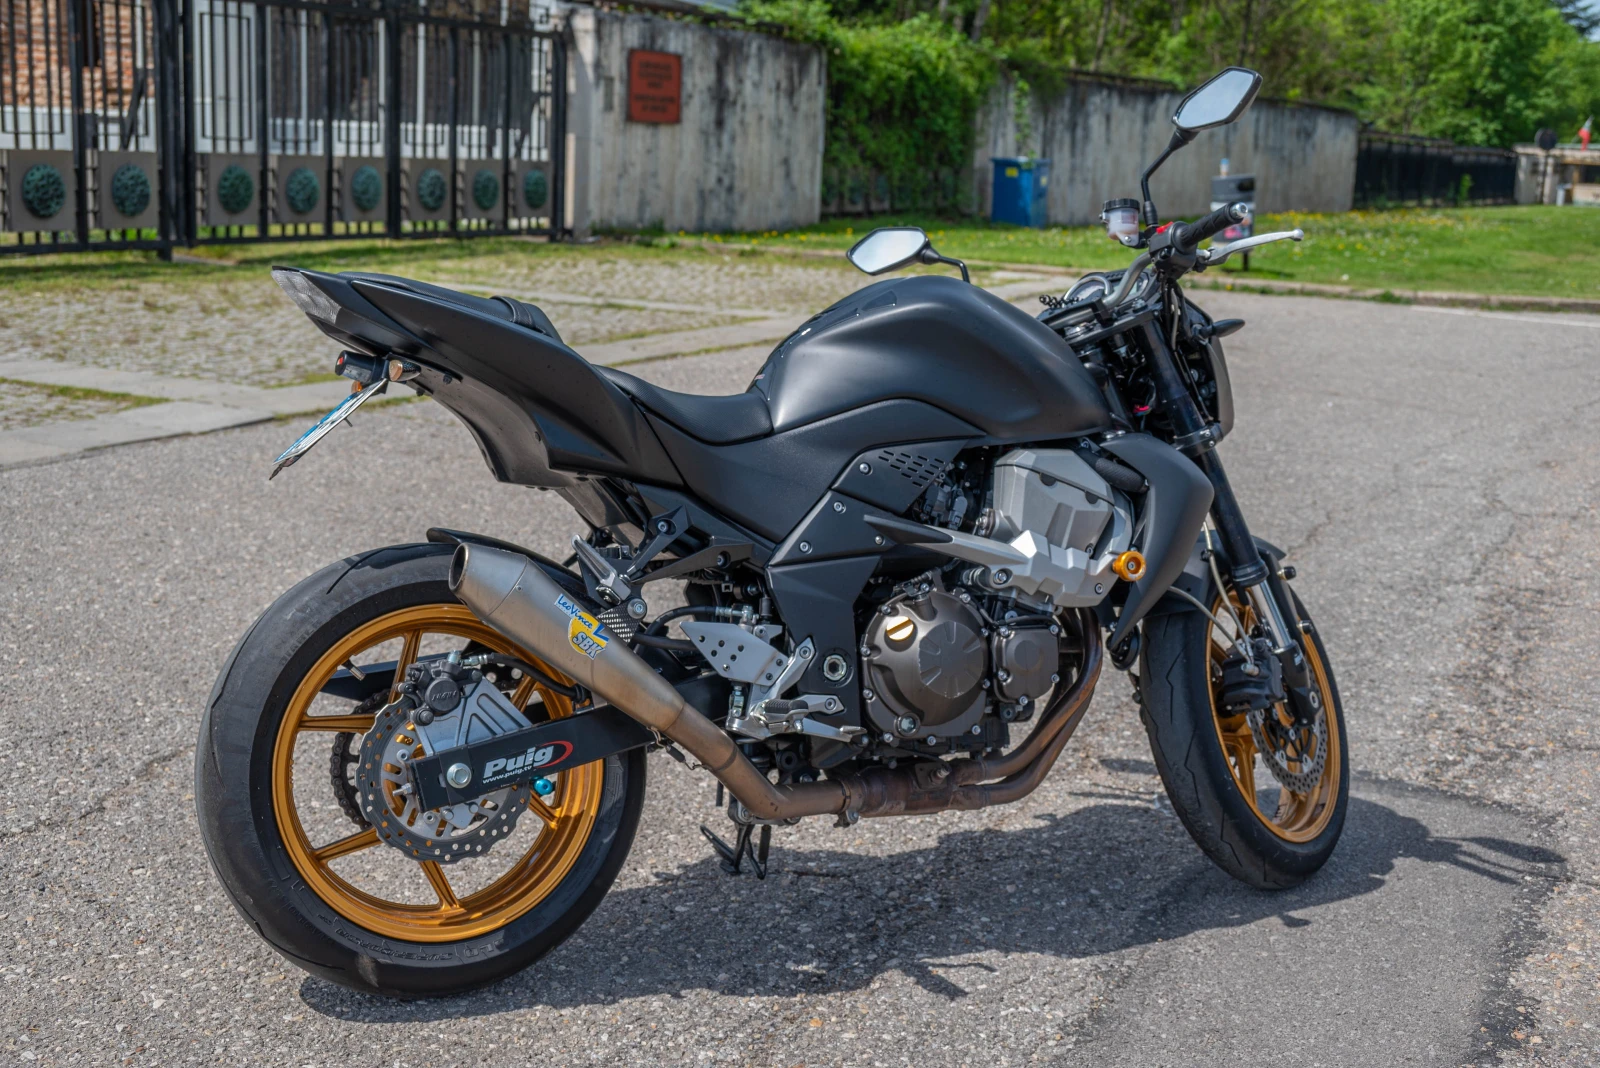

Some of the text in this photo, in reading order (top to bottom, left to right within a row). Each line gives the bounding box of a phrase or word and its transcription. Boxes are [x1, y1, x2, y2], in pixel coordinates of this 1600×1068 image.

[557, 595, 593, 629] LeoVince
[572, 631, 604, 659] SBK
[483, 745, 554, 779] Puig
